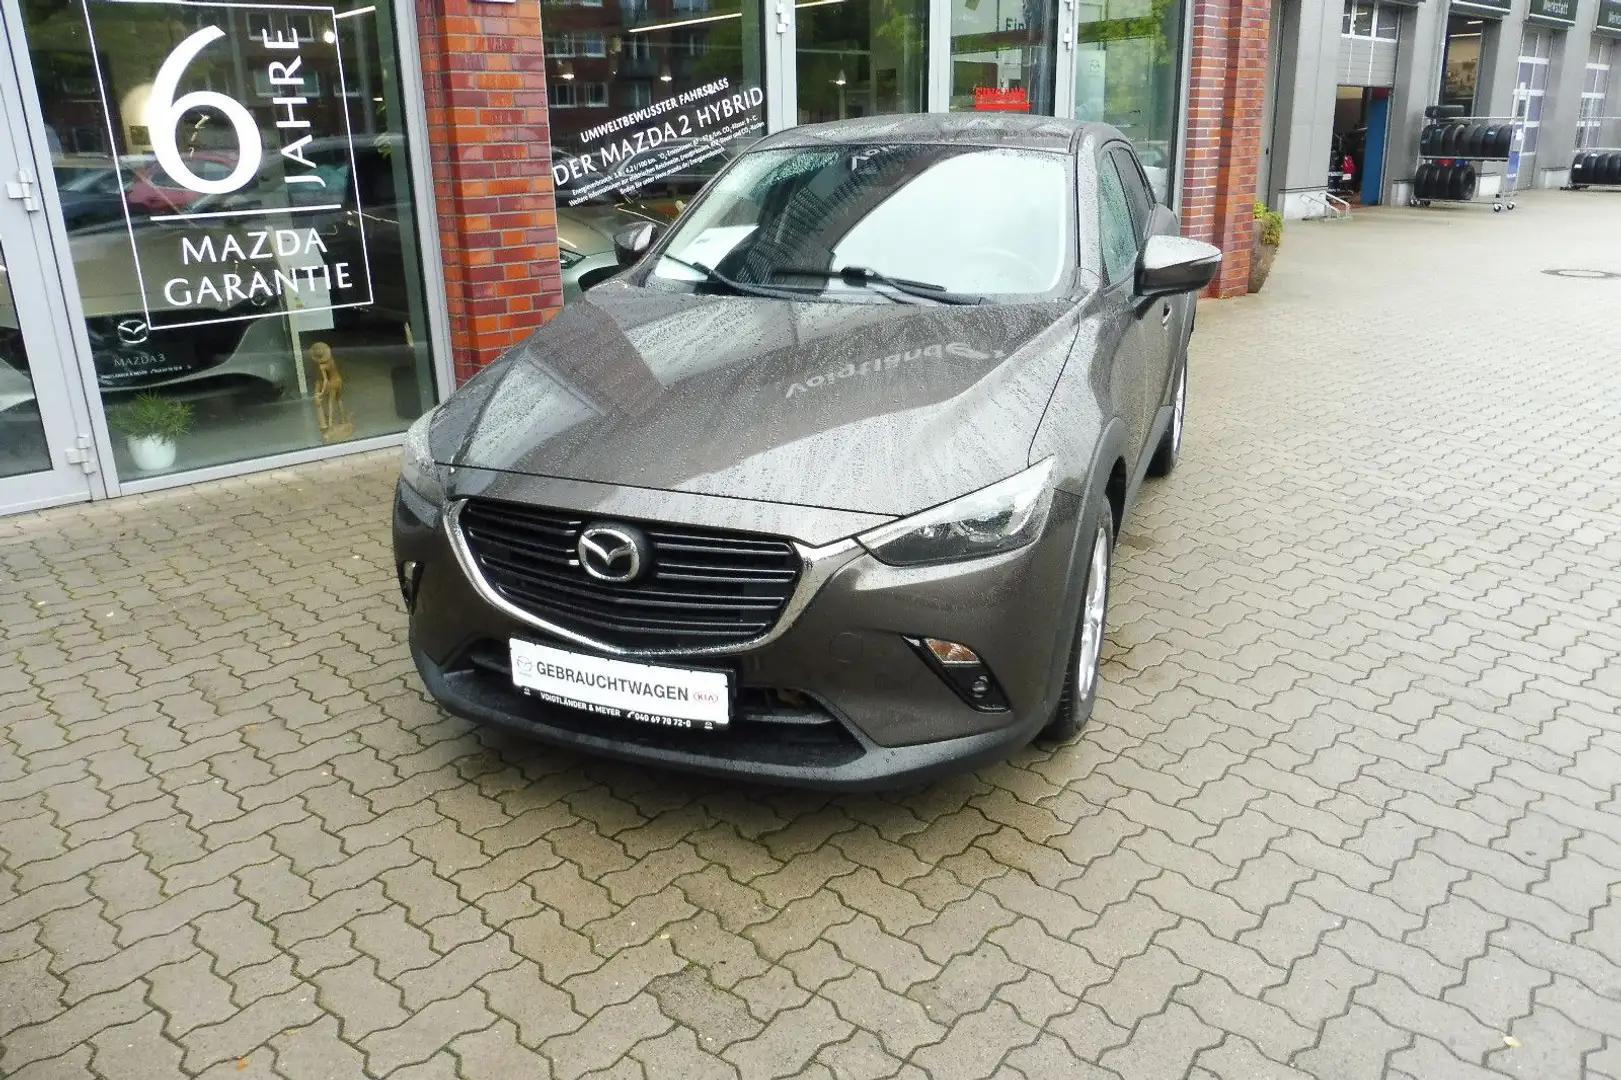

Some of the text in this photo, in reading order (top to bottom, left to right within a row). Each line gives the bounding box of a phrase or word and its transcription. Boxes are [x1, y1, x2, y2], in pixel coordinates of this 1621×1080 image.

[148, 24, 262, 195] 6
[262, 26, 327, 188] JAHRE
[580, 97, 679, 143] UMWELTBEWUSSTER
[551, 87, 764, 187] DER MAZDA 2 HYBRID
[181, 227, 328, 266] MAZDA
[163, 262, 353, 307] GARANTIE
[114, 353, 166, 367] MAZDA 3
[535, 660, 689, 702] GEBRAUCHTWAGEN
[588, 703, 595, 712] &
[595, 705, 621, 717] MEYER
[651, 714, 660, 723] 69
